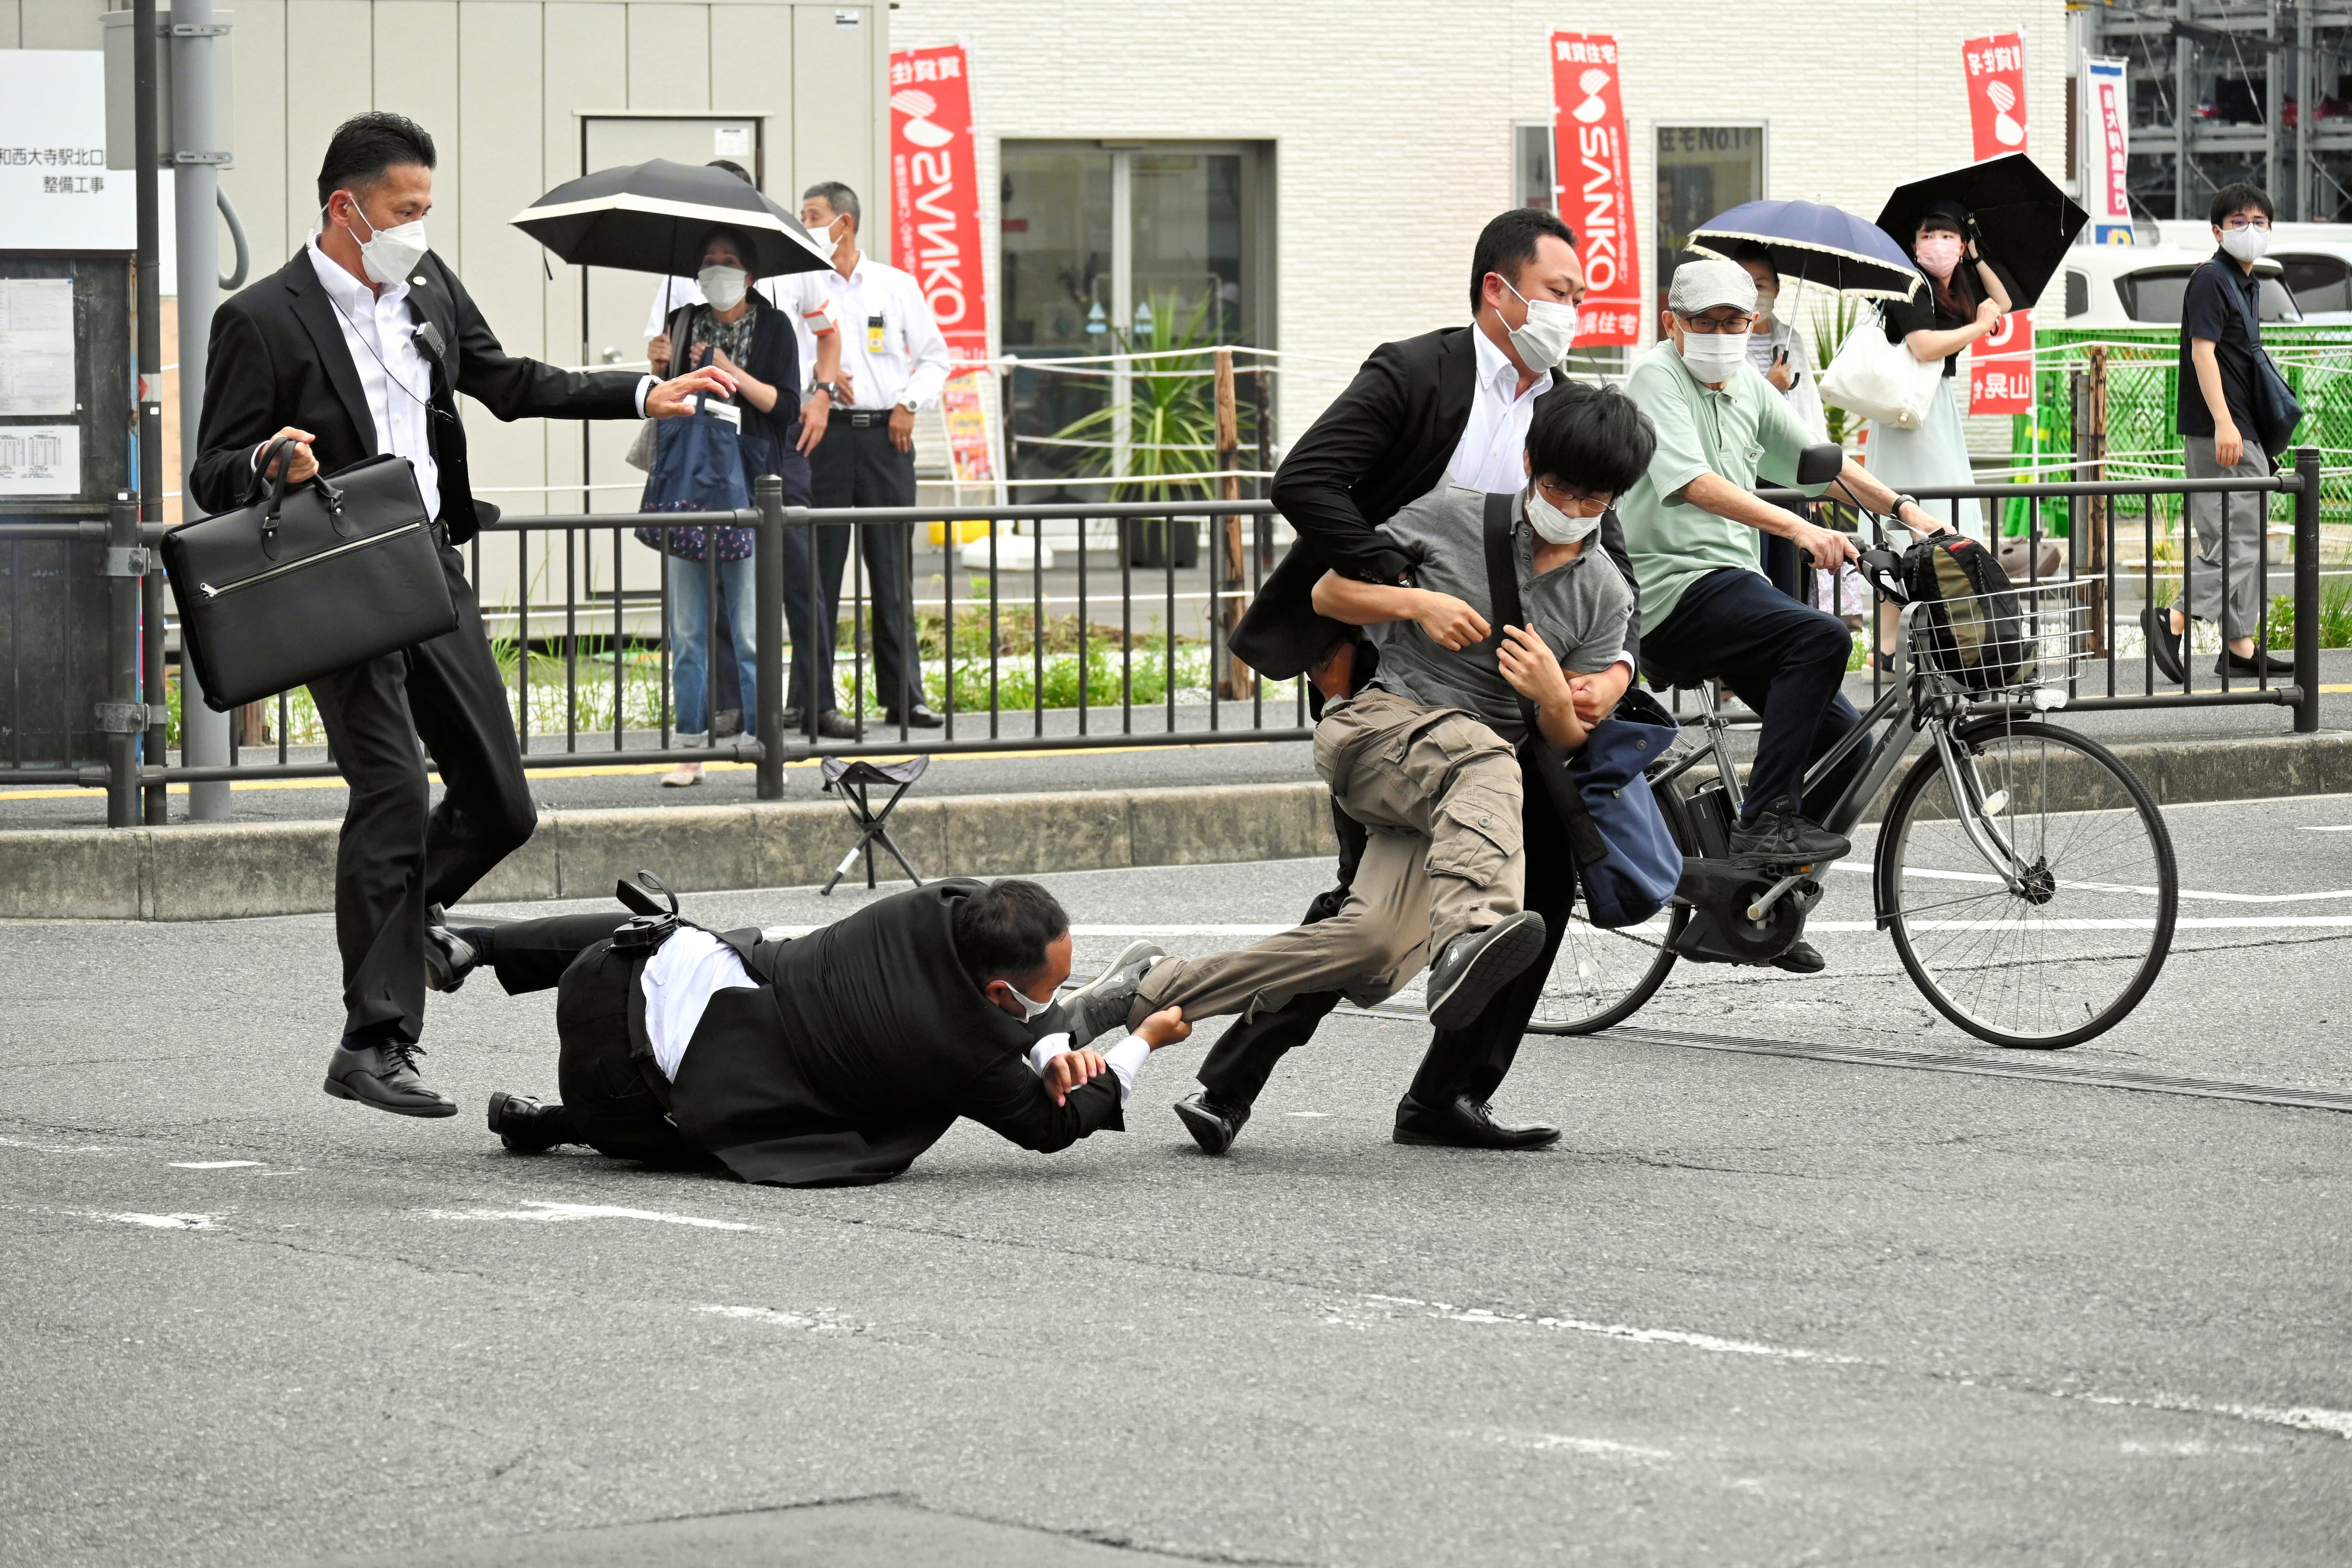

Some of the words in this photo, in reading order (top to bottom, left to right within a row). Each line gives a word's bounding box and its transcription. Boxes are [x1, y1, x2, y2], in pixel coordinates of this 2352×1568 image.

[1556, 40, 1617, 64] 賃貸住宅
[43, 176, 103, 193] 整備工事
[1579, 127, 1616, 291] SANKO
